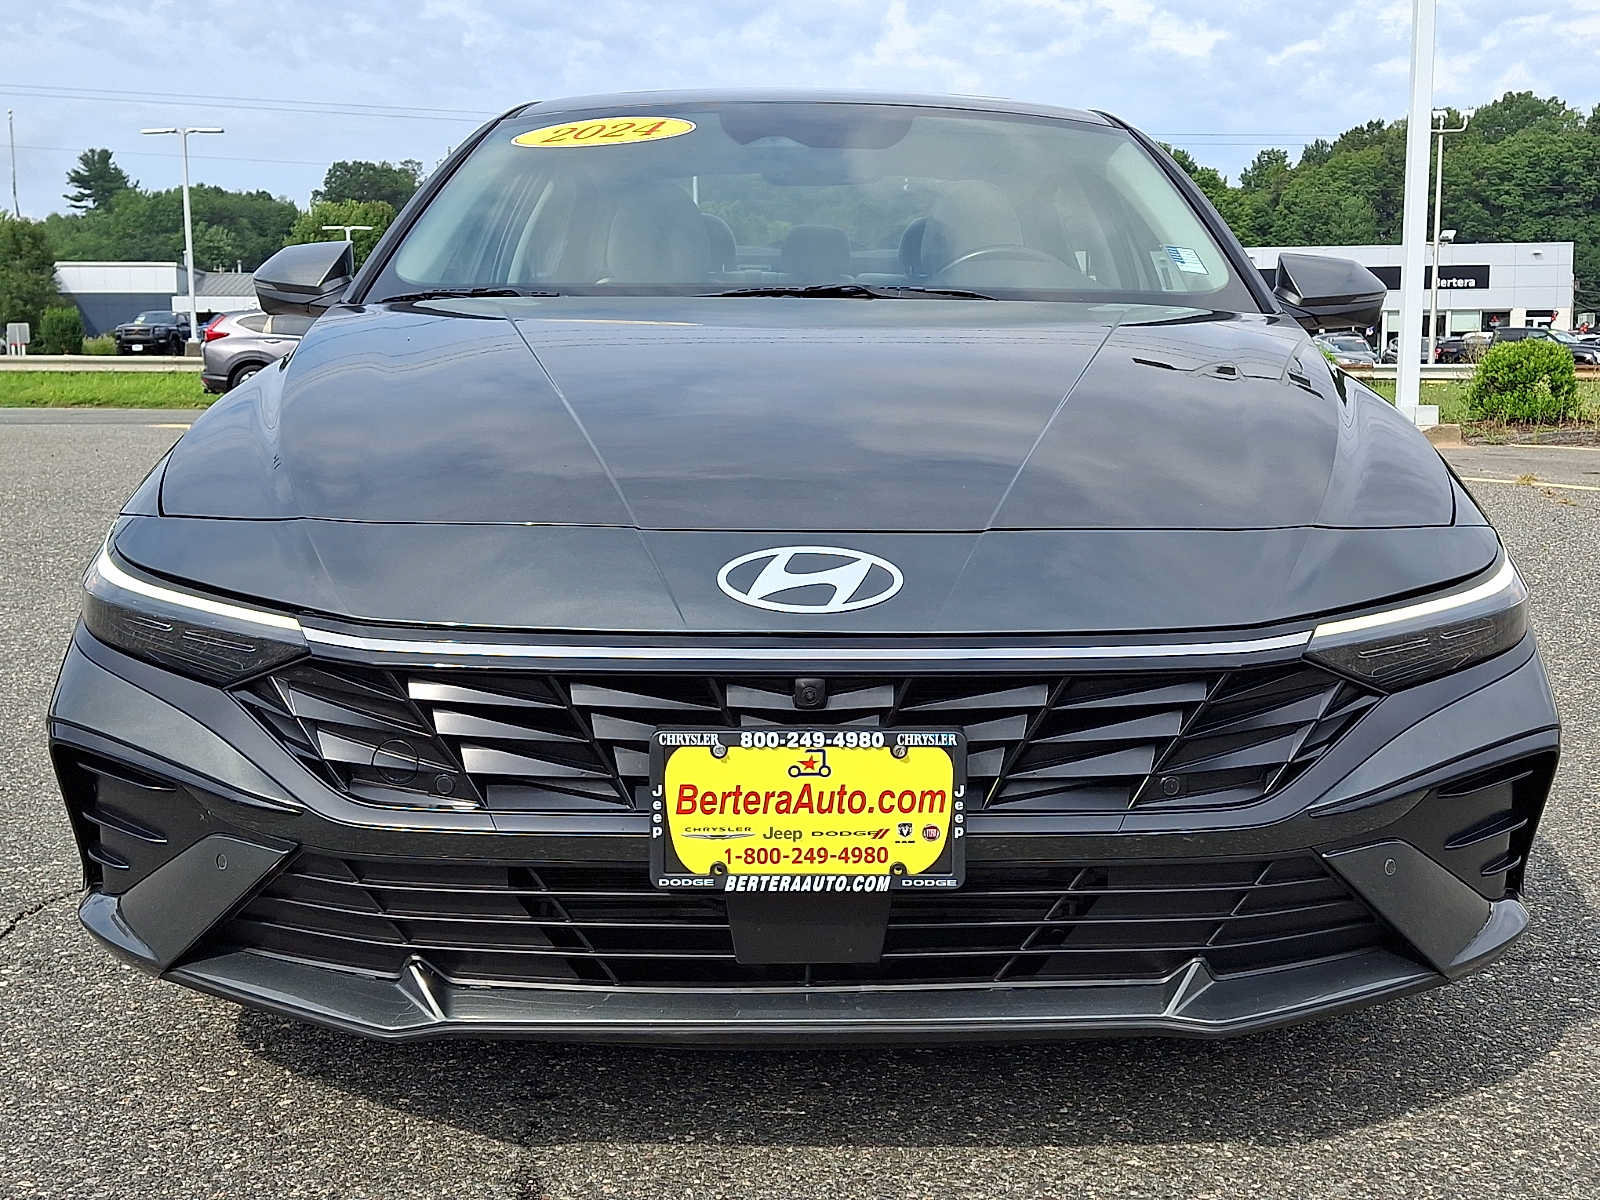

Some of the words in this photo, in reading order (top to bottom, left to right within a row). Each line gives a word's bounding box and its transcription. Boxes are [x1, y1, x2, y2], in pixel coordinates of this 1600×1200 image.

[541, 121, 667, 143] 2024
[659, 733, 720, 746] CHRYSLER
[740, 731, 884, 748] 800-249-4980
[896, 733, 957, 746] CHRYSLER
[676, 783, 947, 815] BerteraAuto.com
[652, 785, 663, 839] Jeep
[954, 785, 965, 839] Jeep
[762, 826, 803, 842] Jeep
[724, 847, 889, 865] 1-800-249-4980
[658, 878, 714, 887] DODGE
[724, 875, 891, 892] BERTERAAUTO.COM
[901, 878, 957, 887] DODGE
